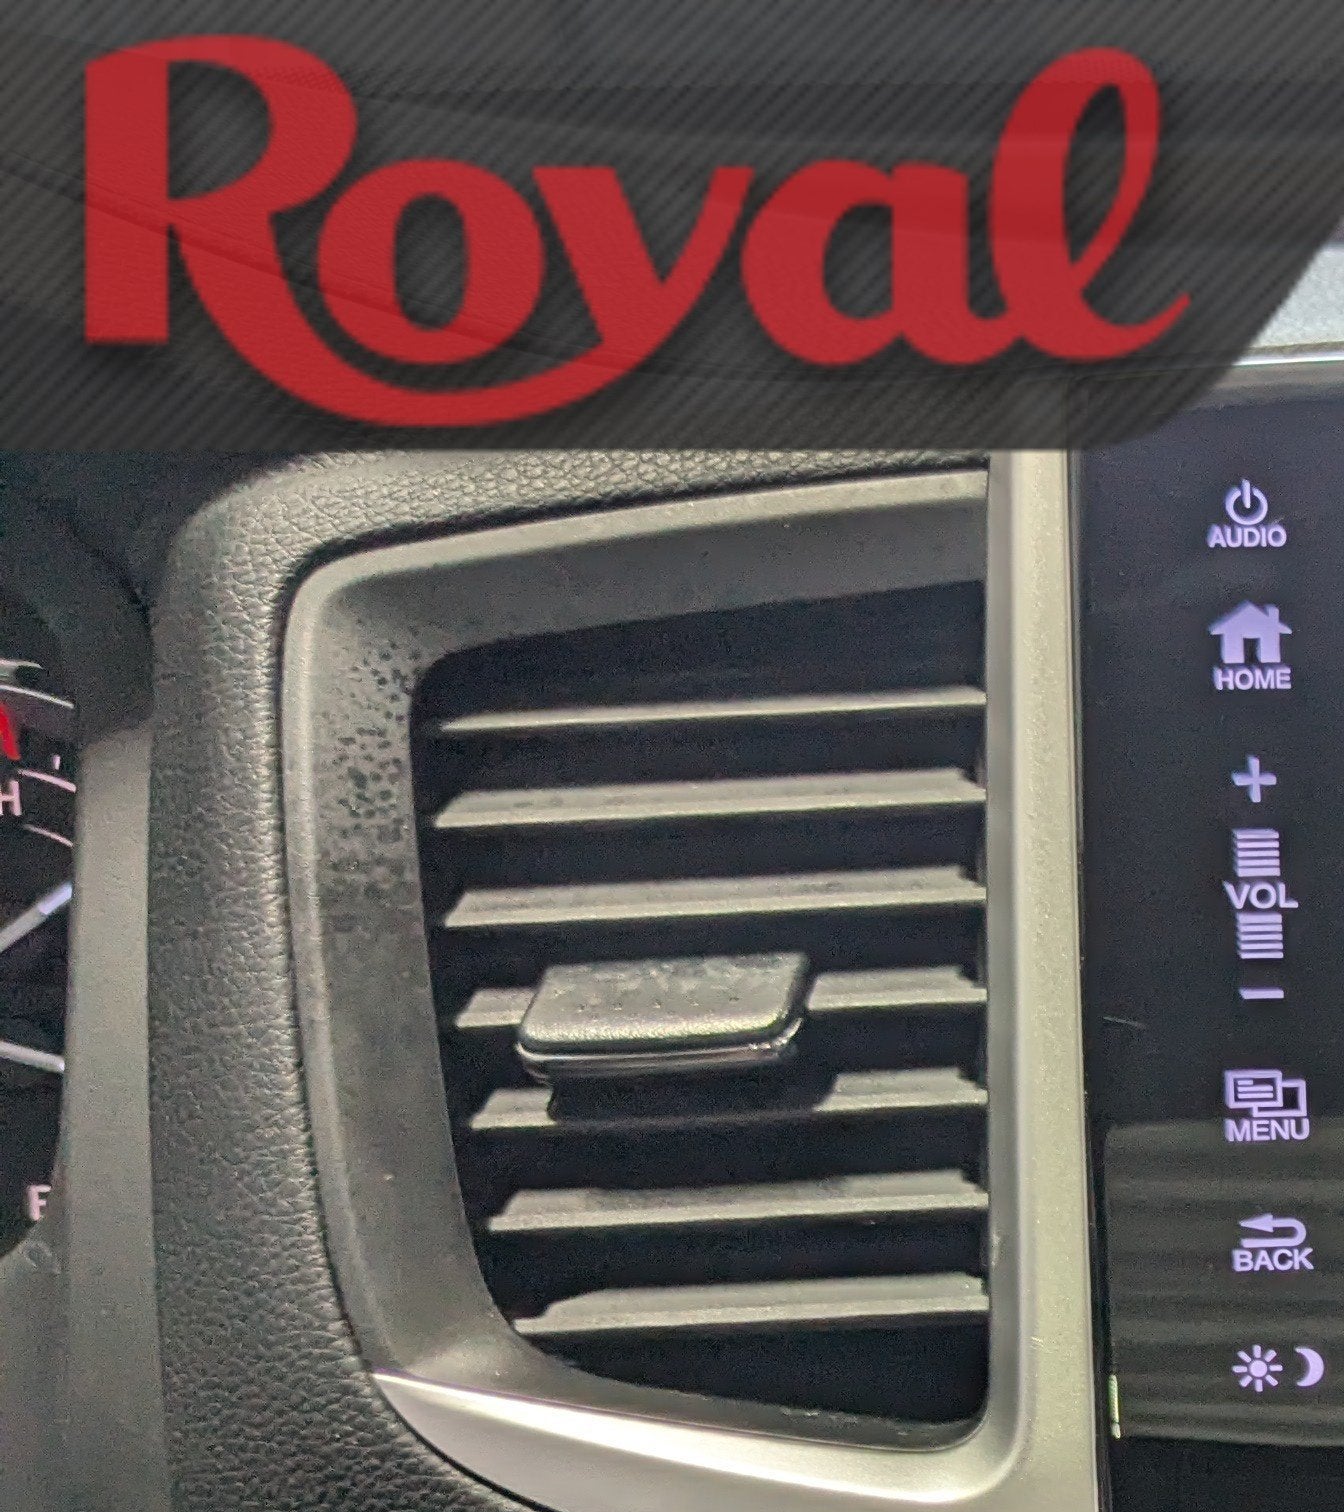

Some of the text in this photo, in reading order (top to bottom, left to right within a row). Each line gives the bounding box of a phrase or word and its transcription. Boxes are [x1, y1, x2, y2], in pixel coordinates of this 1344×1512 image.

[1208, 525, 1287, 548] AUDIO
[1214, 667, 1291, 690] HOME
[1223, 881, 1298, 909] VOL
[1225, 1118, 1310, 1142] MENU
[1232, 1248, 1314, 1272] BACK
